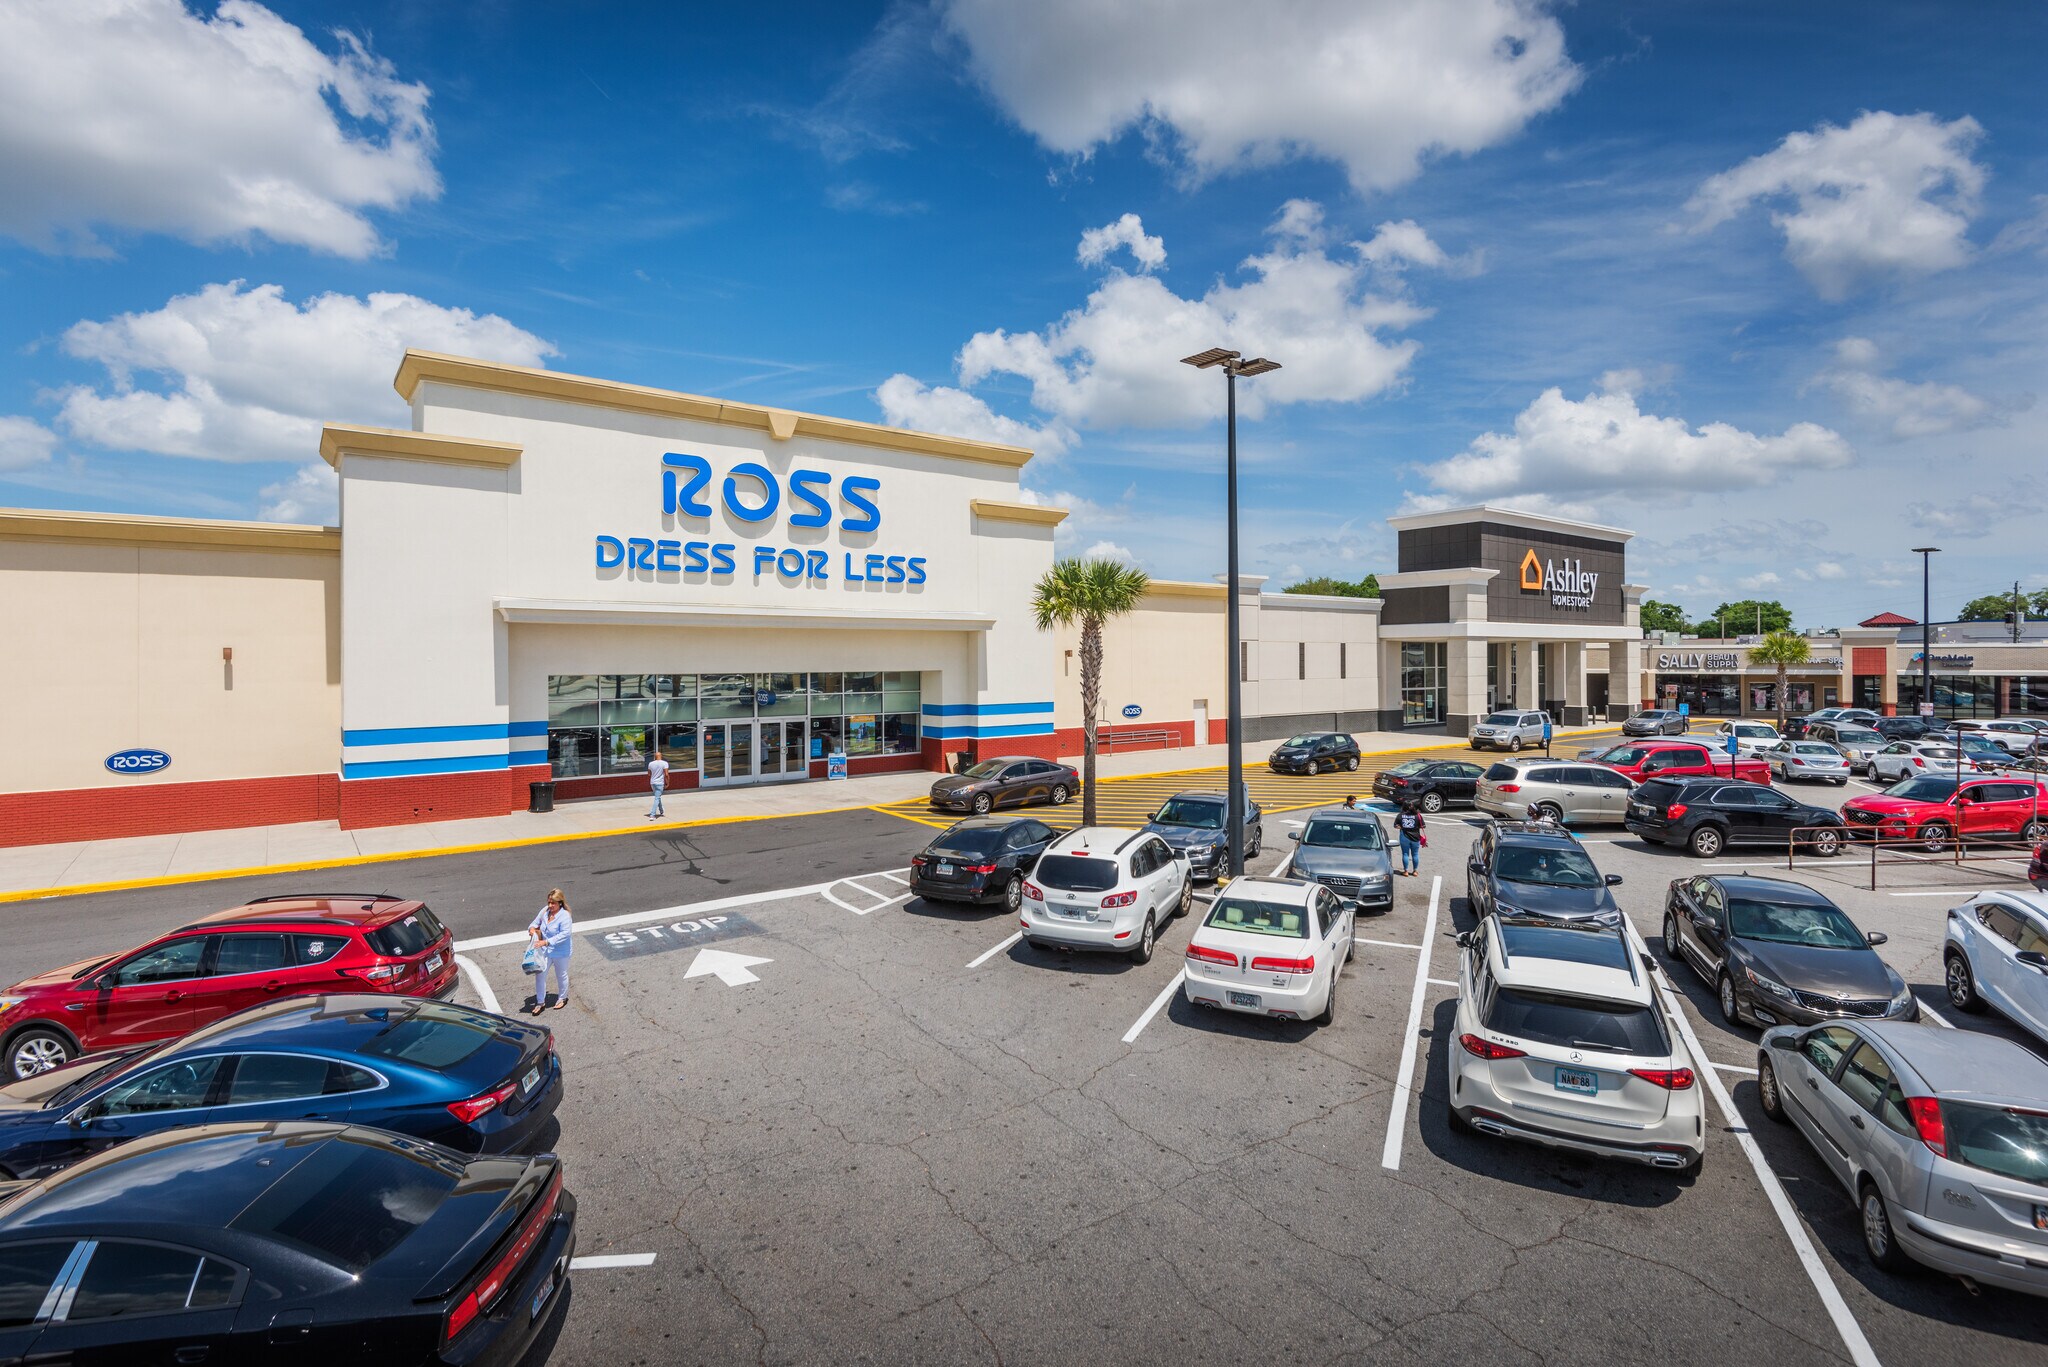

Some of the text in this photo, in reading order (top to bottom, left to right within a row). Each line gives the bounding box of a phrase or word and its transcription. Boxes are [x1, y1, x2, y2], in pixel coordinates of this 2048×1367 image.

[662, 452, 881, 533] ROSS
[596, 535, 927, 585] DRESS FOR LESS
[1543, 558, 1599, 603] Ashley
[1552, 594, 1591, 608] HOMESTORE
[1659, 653, 1705, 668] SALLY
[1707, 653, 1740, 661] BEAUTY
[1707, 660, 1741, 668] SUPPLY
[757, 693, 769, 702] ROSS
[1124, 707, 1141, 715] ROSS
[113, 754, 164, 769] ROSS
[1401, 817, 1416, 829] 22
[604, 915, 728, 944] STOP
[1580, 1077, 1590, 1087] 88
